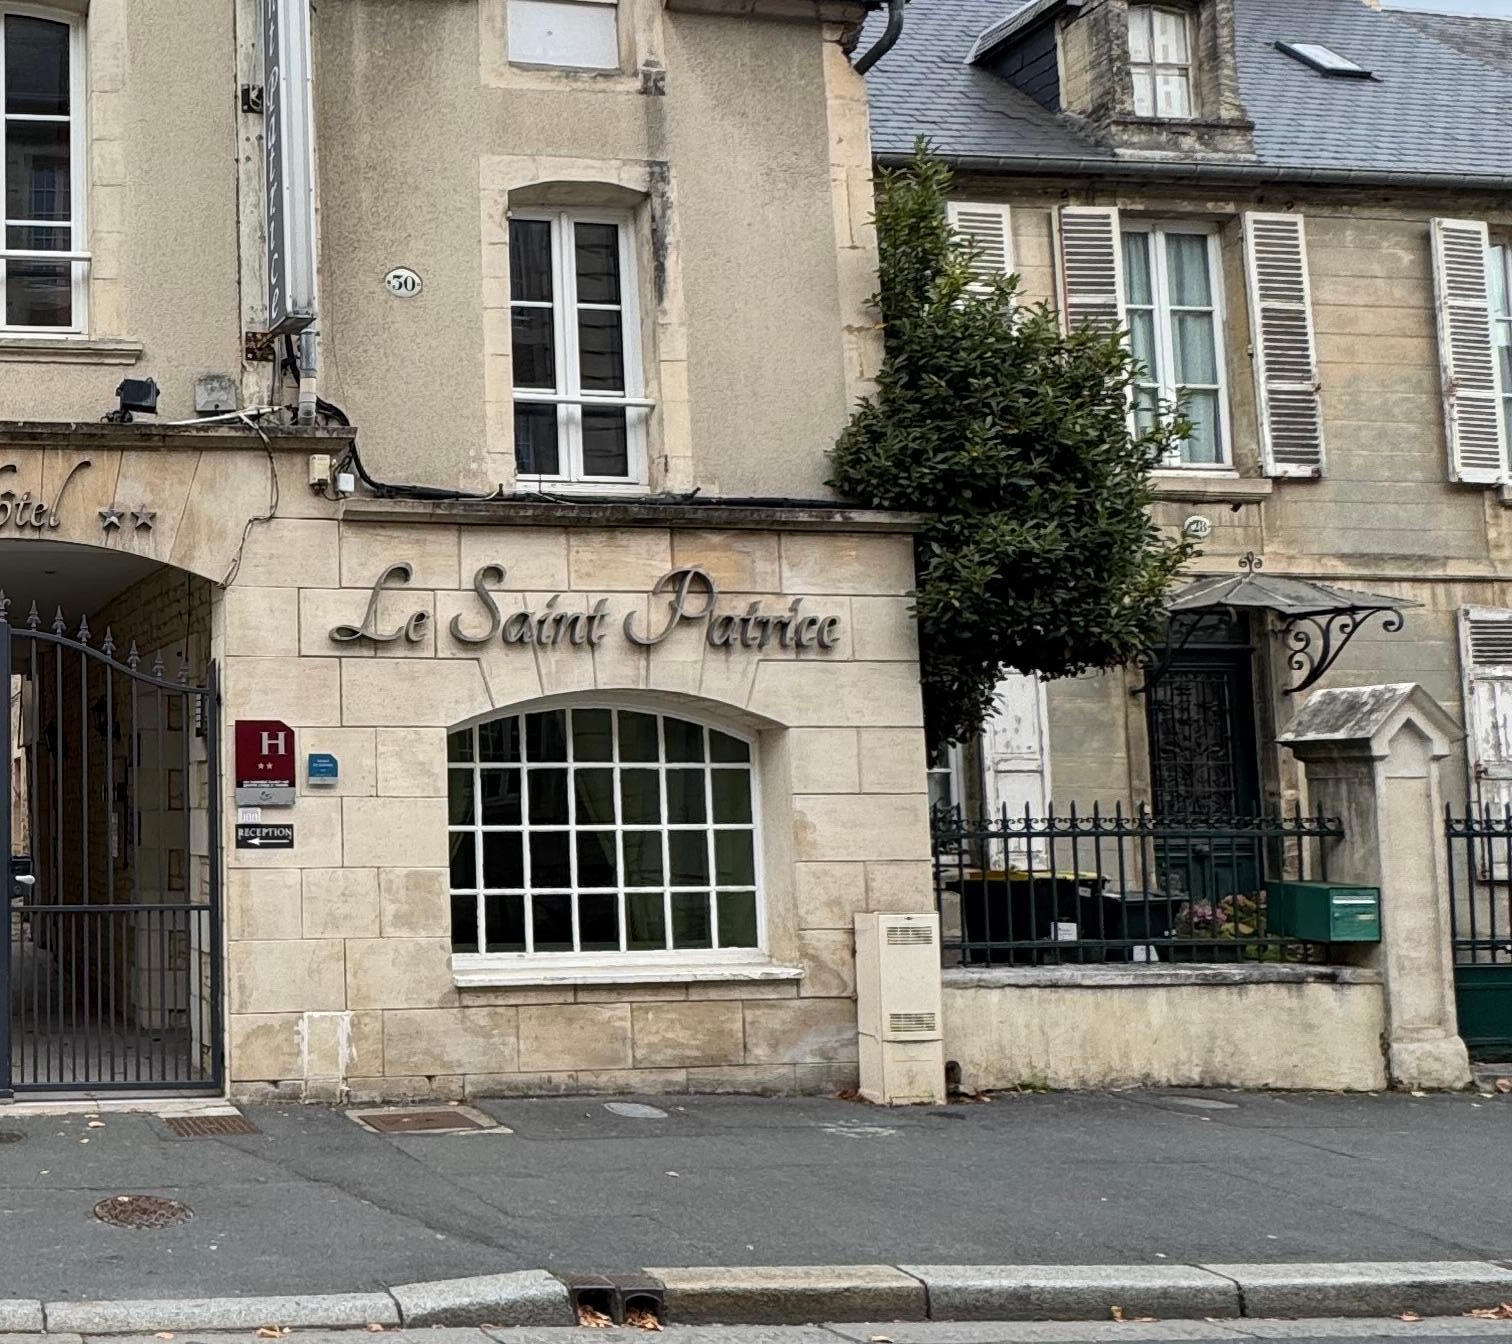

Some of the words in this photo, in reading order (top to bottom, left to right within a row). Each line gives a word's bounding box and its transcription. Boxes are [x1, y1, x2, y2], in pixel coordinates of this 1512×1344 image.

[392, 274, 416, 292] 50
[328, 561, 430, 643] Le
[449, 562, 610, 646] Saint
[622, 564, 842, 650] Patrice
[259, 731, 287, 755] H
